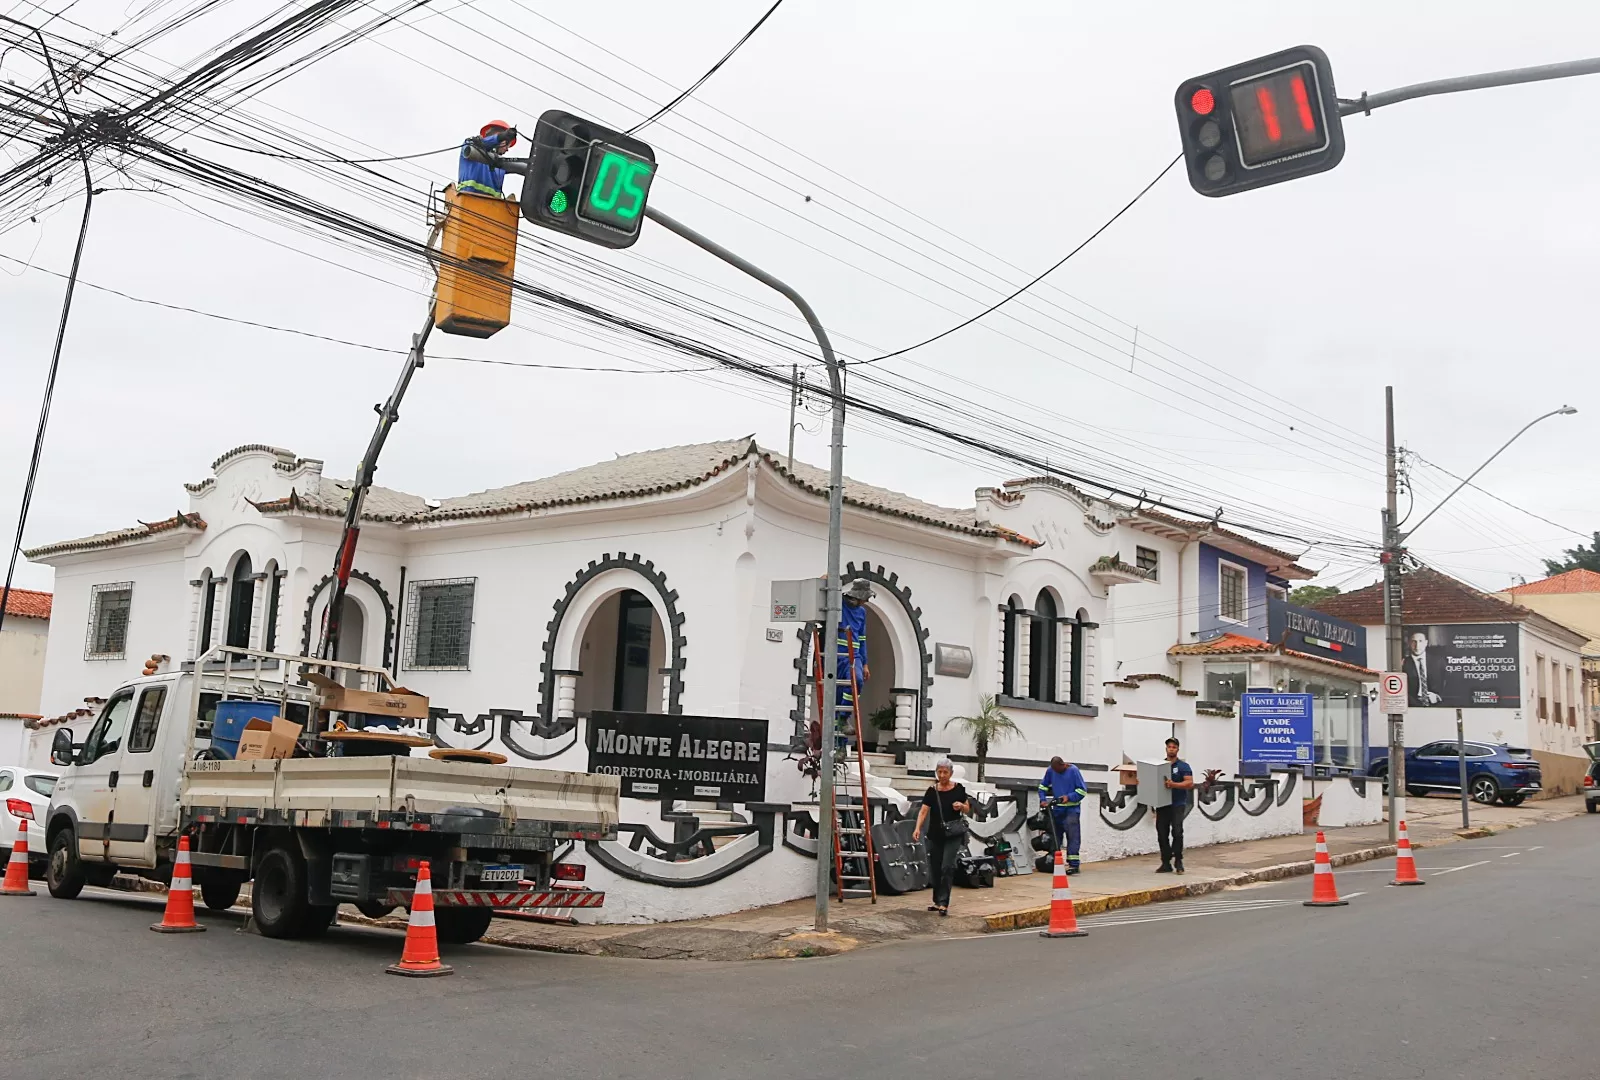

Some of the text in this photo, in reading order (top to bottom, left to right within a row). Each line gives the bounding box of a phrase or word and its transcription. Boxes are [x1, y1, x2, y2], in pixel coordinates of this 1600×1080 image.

[1256, 74, 1316, 141] 11
[590, 151, 652, 219] 05
[1286, 611, 1357, 647] TERNOS TARDIOLI
[1446, 656, 1478, 664] Tardioli,
[1463, 672, 1498, 680] imagem
[1389, 679, 1397, 690] E
[1249, 697, 1304, 706] MONTE ALEGRE
[1262, 718, 1291, 726] VENDE
[1258, 727, 1295, 735] COMPRA
[596, 728, 760, 762] MONTE ALEGRE
[1263, 736, 1291, 744] ALUGA
[485, 870, 520, 881] ETV2C91
